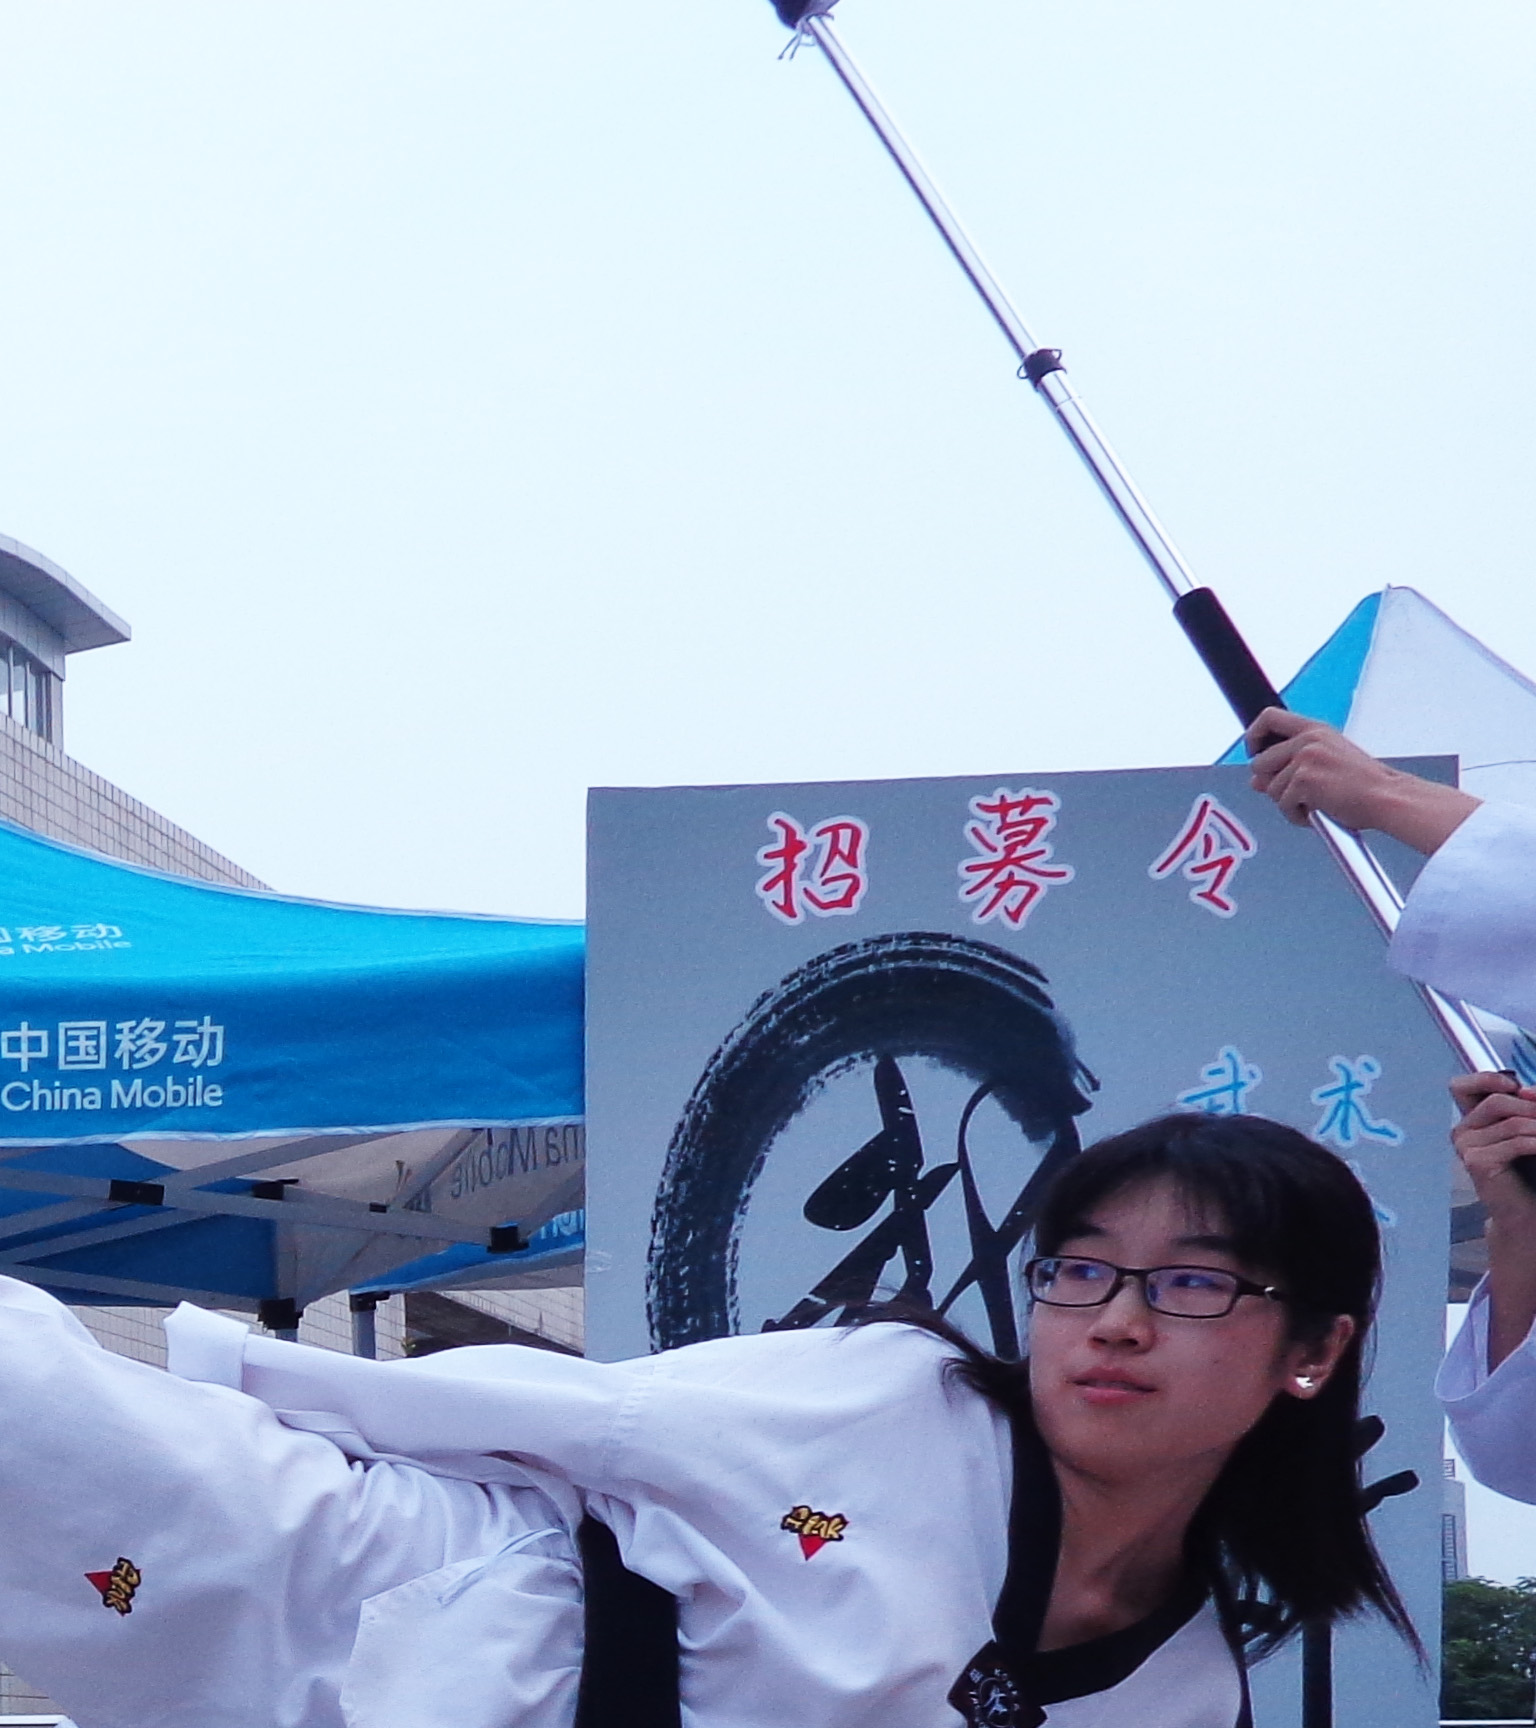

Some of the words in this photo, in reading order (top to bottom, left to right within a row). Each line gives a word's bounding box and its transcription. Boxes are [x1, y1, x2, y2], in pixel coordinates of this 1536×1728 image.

[760, 793, 1254, 925] 招募令
[24, 938, 132, 956] Mobile
[0, 1015, 225, 1073] 中国移动
[0, 1081, 102, 1113] China
[110, 1075, 224, 1110] Mobile
